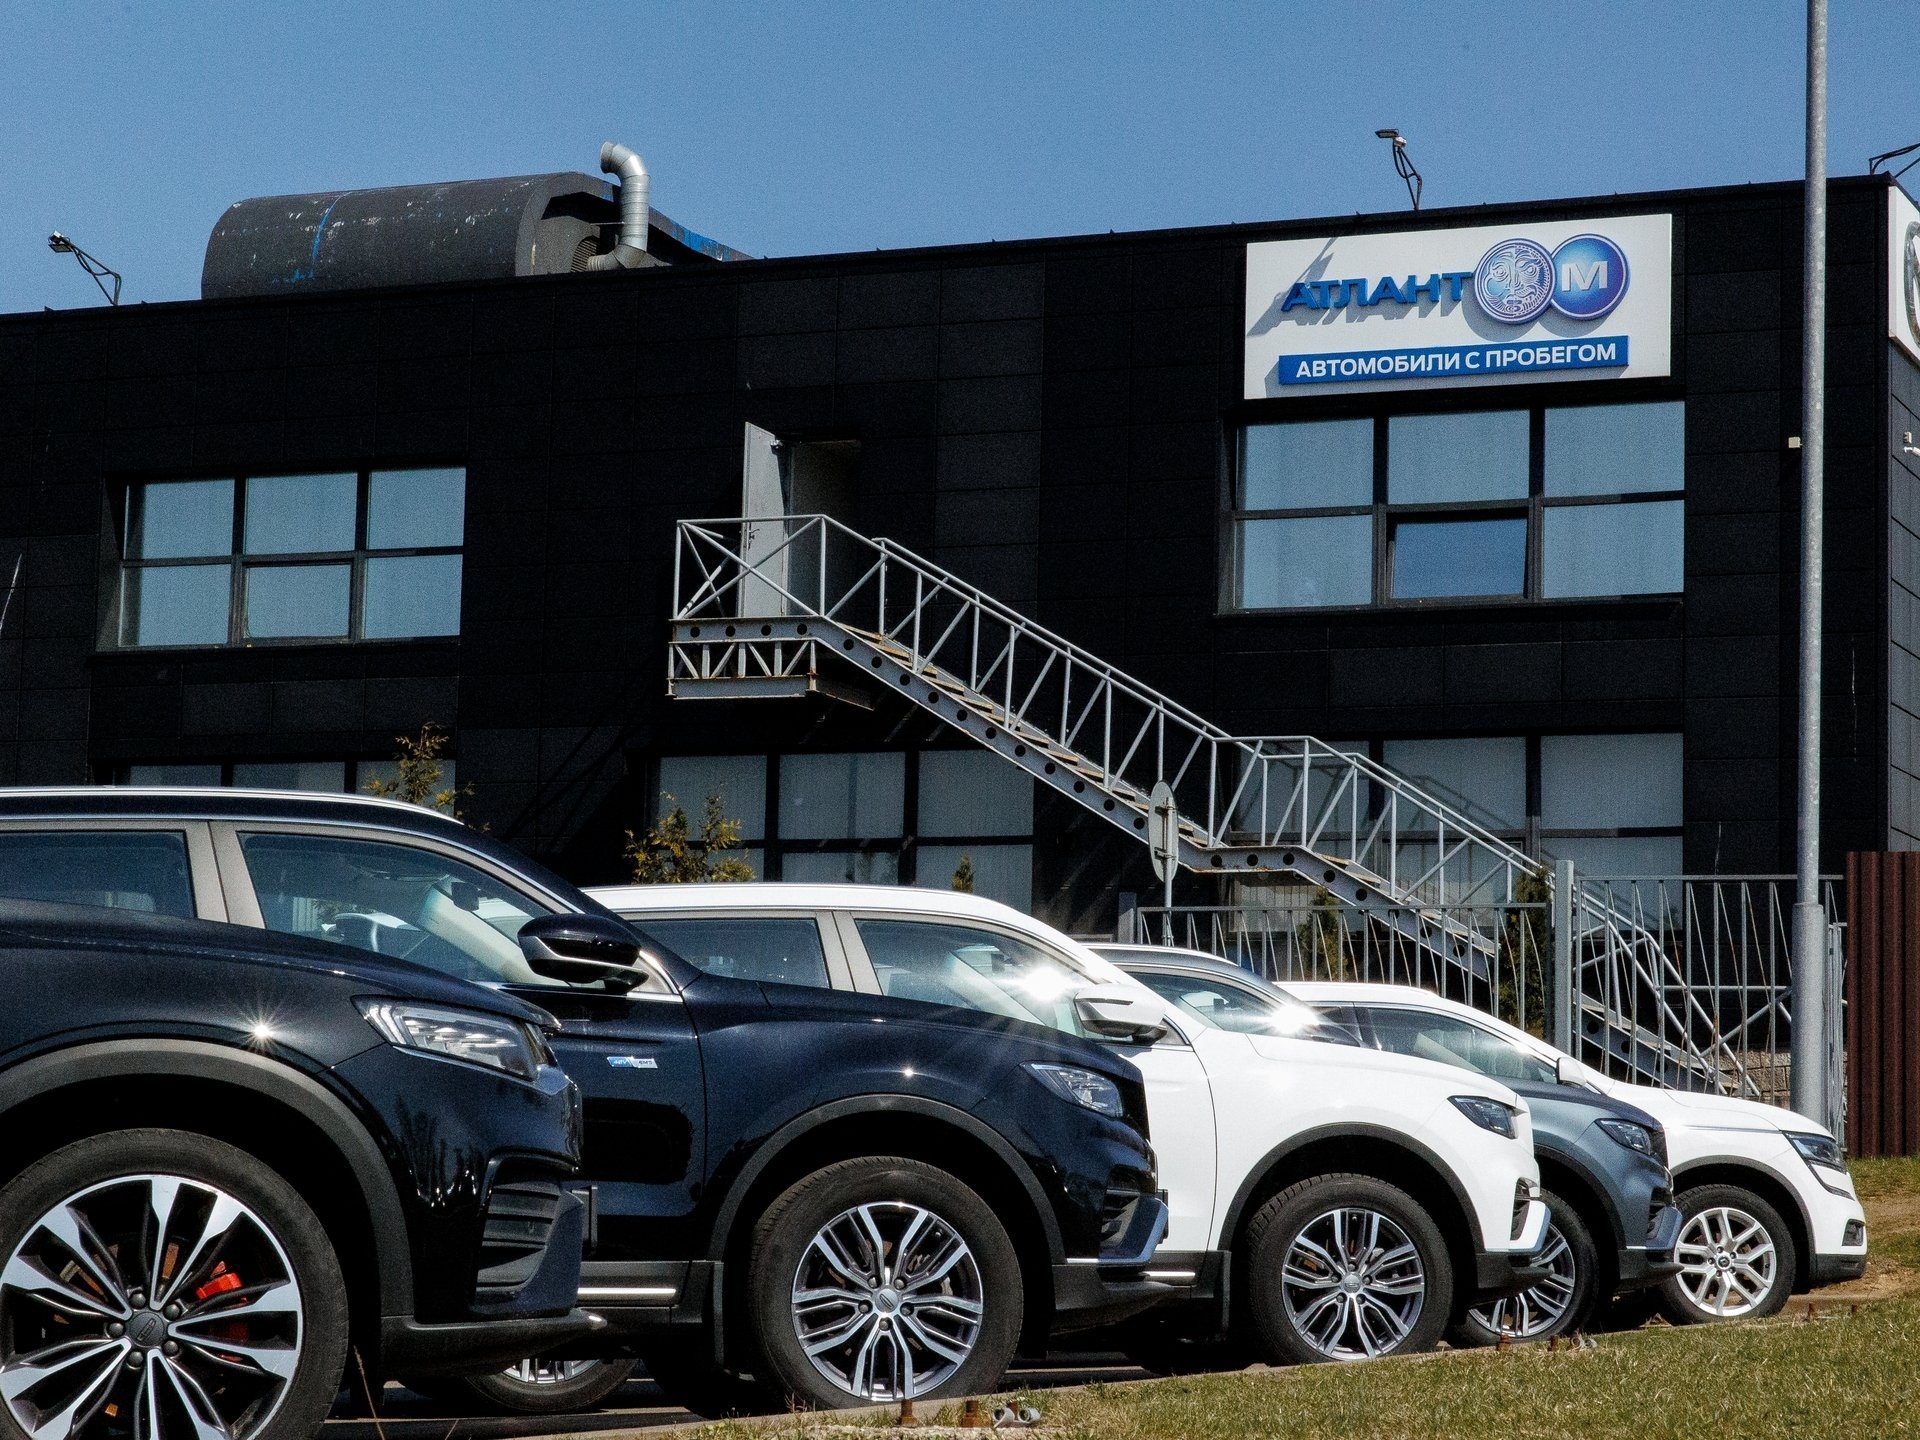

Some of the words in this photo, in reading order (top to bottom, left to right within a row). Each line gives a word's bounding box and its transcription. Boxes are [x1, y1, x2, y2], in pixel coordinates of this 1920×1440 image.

[1281, 271, 1473, 312] АТЛАНТ
[1562, 260, 1608, 292] М
[1296, 352, 1460, 378] АВТОМОБИЛИ
[1465, 351, 1480, 369] С
[1485, 343, 1616, 368] ПРОБЕГОМ
